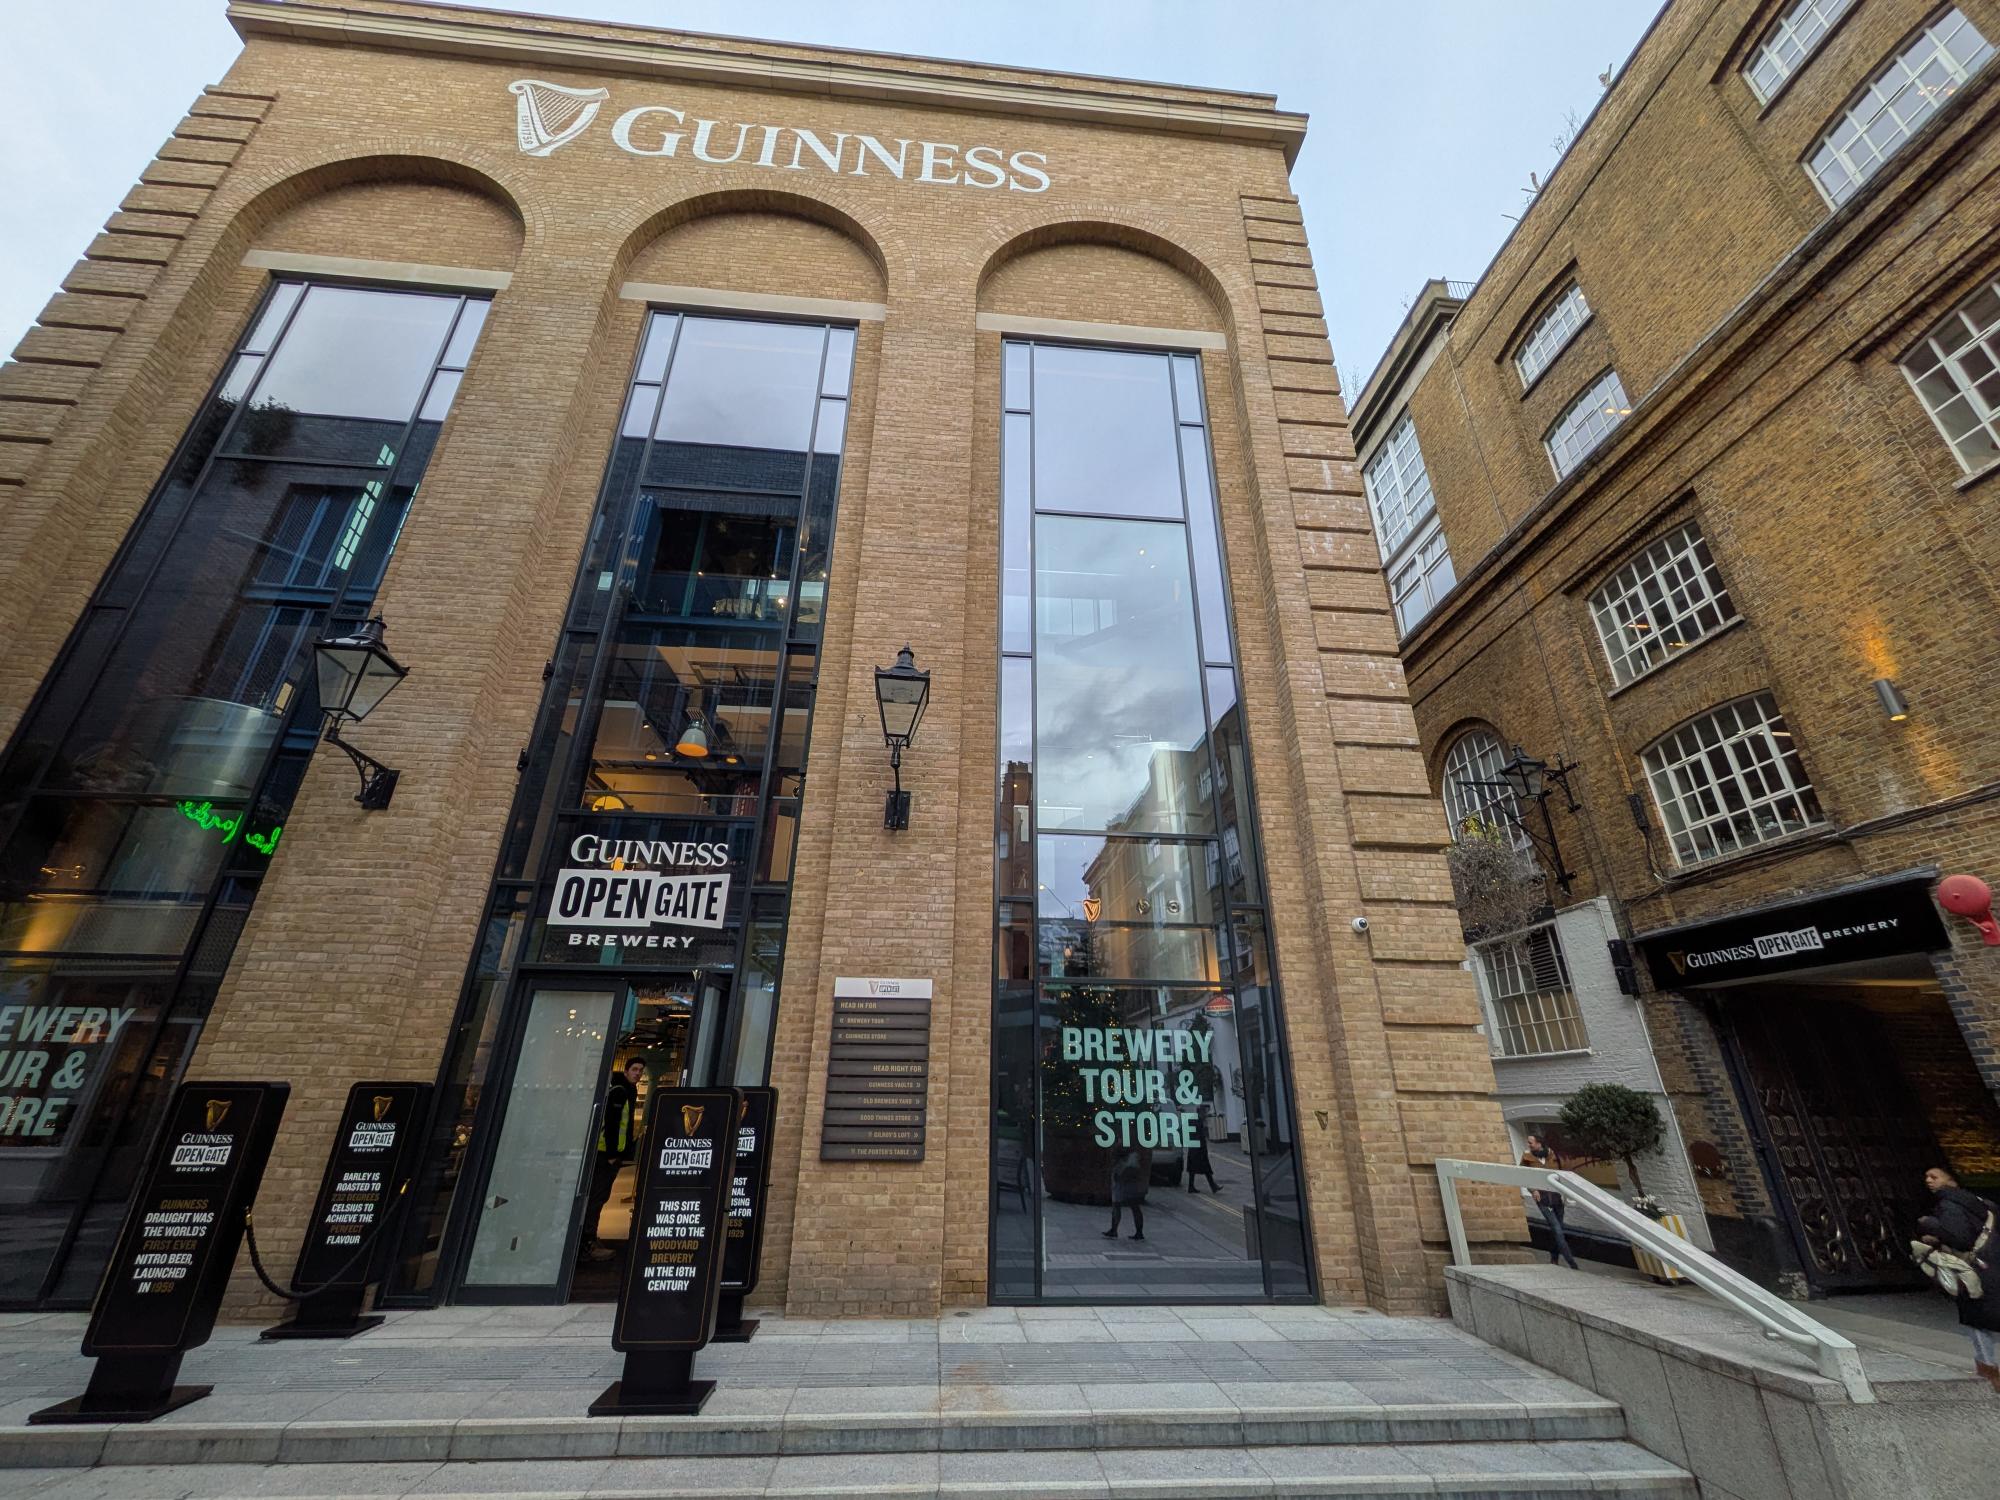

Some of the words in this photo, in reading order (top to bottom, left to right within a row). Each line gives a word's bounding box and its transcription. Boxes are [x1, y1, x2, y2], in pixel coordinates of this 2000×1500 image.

[610, 106, 1052, 194] GUINNESS
[571, 834, 728, 867] GUINNESS
[558, 876, 652, 919] OPEN
[654, 881, 723, 921] GATE
[568, 933, 695, 948] BREWERY
[1686, 944, 1757, 968] GUINNESS
[1758, 935, 1792, 956] OPEN
[1792, 929, 1820, 949] GATE
[1822, 918, 1899, 940] BREWERY
[0, 1005, 137, 1043] EWERY
[1062, 1027, 1214, 1063] BREWERY
[51, 1050, 87, 1090] &
[1078, 1068, 1168, 1104] TOUR
[1175, 1070, 1202, 1105] &
[356, 1122, 397, 1130] GUINNESS
[1094, 1110, 1200, 1149] STORE
[181, 1132, 234, 1144] GUINNESS
[352, 1134, 375, 1144] OPEN
[375, 1134, 393, 1144] GATE
[664, 1138, 712, 1148] GUINNESS
[175, 1148, 206, 1162] OPEN
[204, 1148, 230, 1162] GATE
[662, 1152, 690, 1166] OPEN
[690, 1152, 710, 1166] GATE
[343, 1172, 372, 1180] BARLEY
[372, 1172, 380, 1180] IS
[336, 1182, 370, 1191] ROASTED
[371, 1182, 382, 1191] TO
[733, 1178, 748, 1186] RST
[732, 1188, 746, 1196] NAL
[160, 1199, 209, 1210] GUINNESS
[332, 1204, 363, 1212] CELSIUS
[364, 1204, 374, 1212] TO
[660, 1201, 680, 1211] THIS
[681, 1201, 700, 1211] SITE
[144, 1212, 192, 1223] DRAUGHT
[192, 1212, 214, 1223] WAS
[326, 1214, 358, 1222] ACHIEVE
[358, 1214, 374, 1222] THE
[738, 1208, 752, 1217] FOR
[656, 1214, 675, 1224] WAS
[676, 1214, 700, 1224] ONCE
[144, 1226, 164, 1237] THE
[164, 1226, 207, 1237] WORLD'S
[330, 1224, 364, 1233] PERFECT
[646, 1227, 673, 1238] HOME
[675, 1227, 688, 1237] TO
[688, 1227, 706, 1238] THE
[142, 1240, 172, 1250] FIRST
[174, 1240, 198, 1250] EVER
[326, 1236, 361, 1244] FLAVOUR
[650, 1240, 699, 1250] WOODYARD
[134, 1254, 168, 1264] NITRO
[168, 1254, 193, 1265] BEER,
[651, 1253, 694, 1264] BREWERY
[133, 1268, 187, 1279] LAUNCHED
[644, 1267, 655, 1278] IN
[657, 1266, 674, 1277] THE
[675, 1266, 696, 1277] 18TH
[138, 1282, 152, 1293] IN
[152, 1282, 174, 1292] 1959
[648, 1280, 690, 1291] CENTURY
